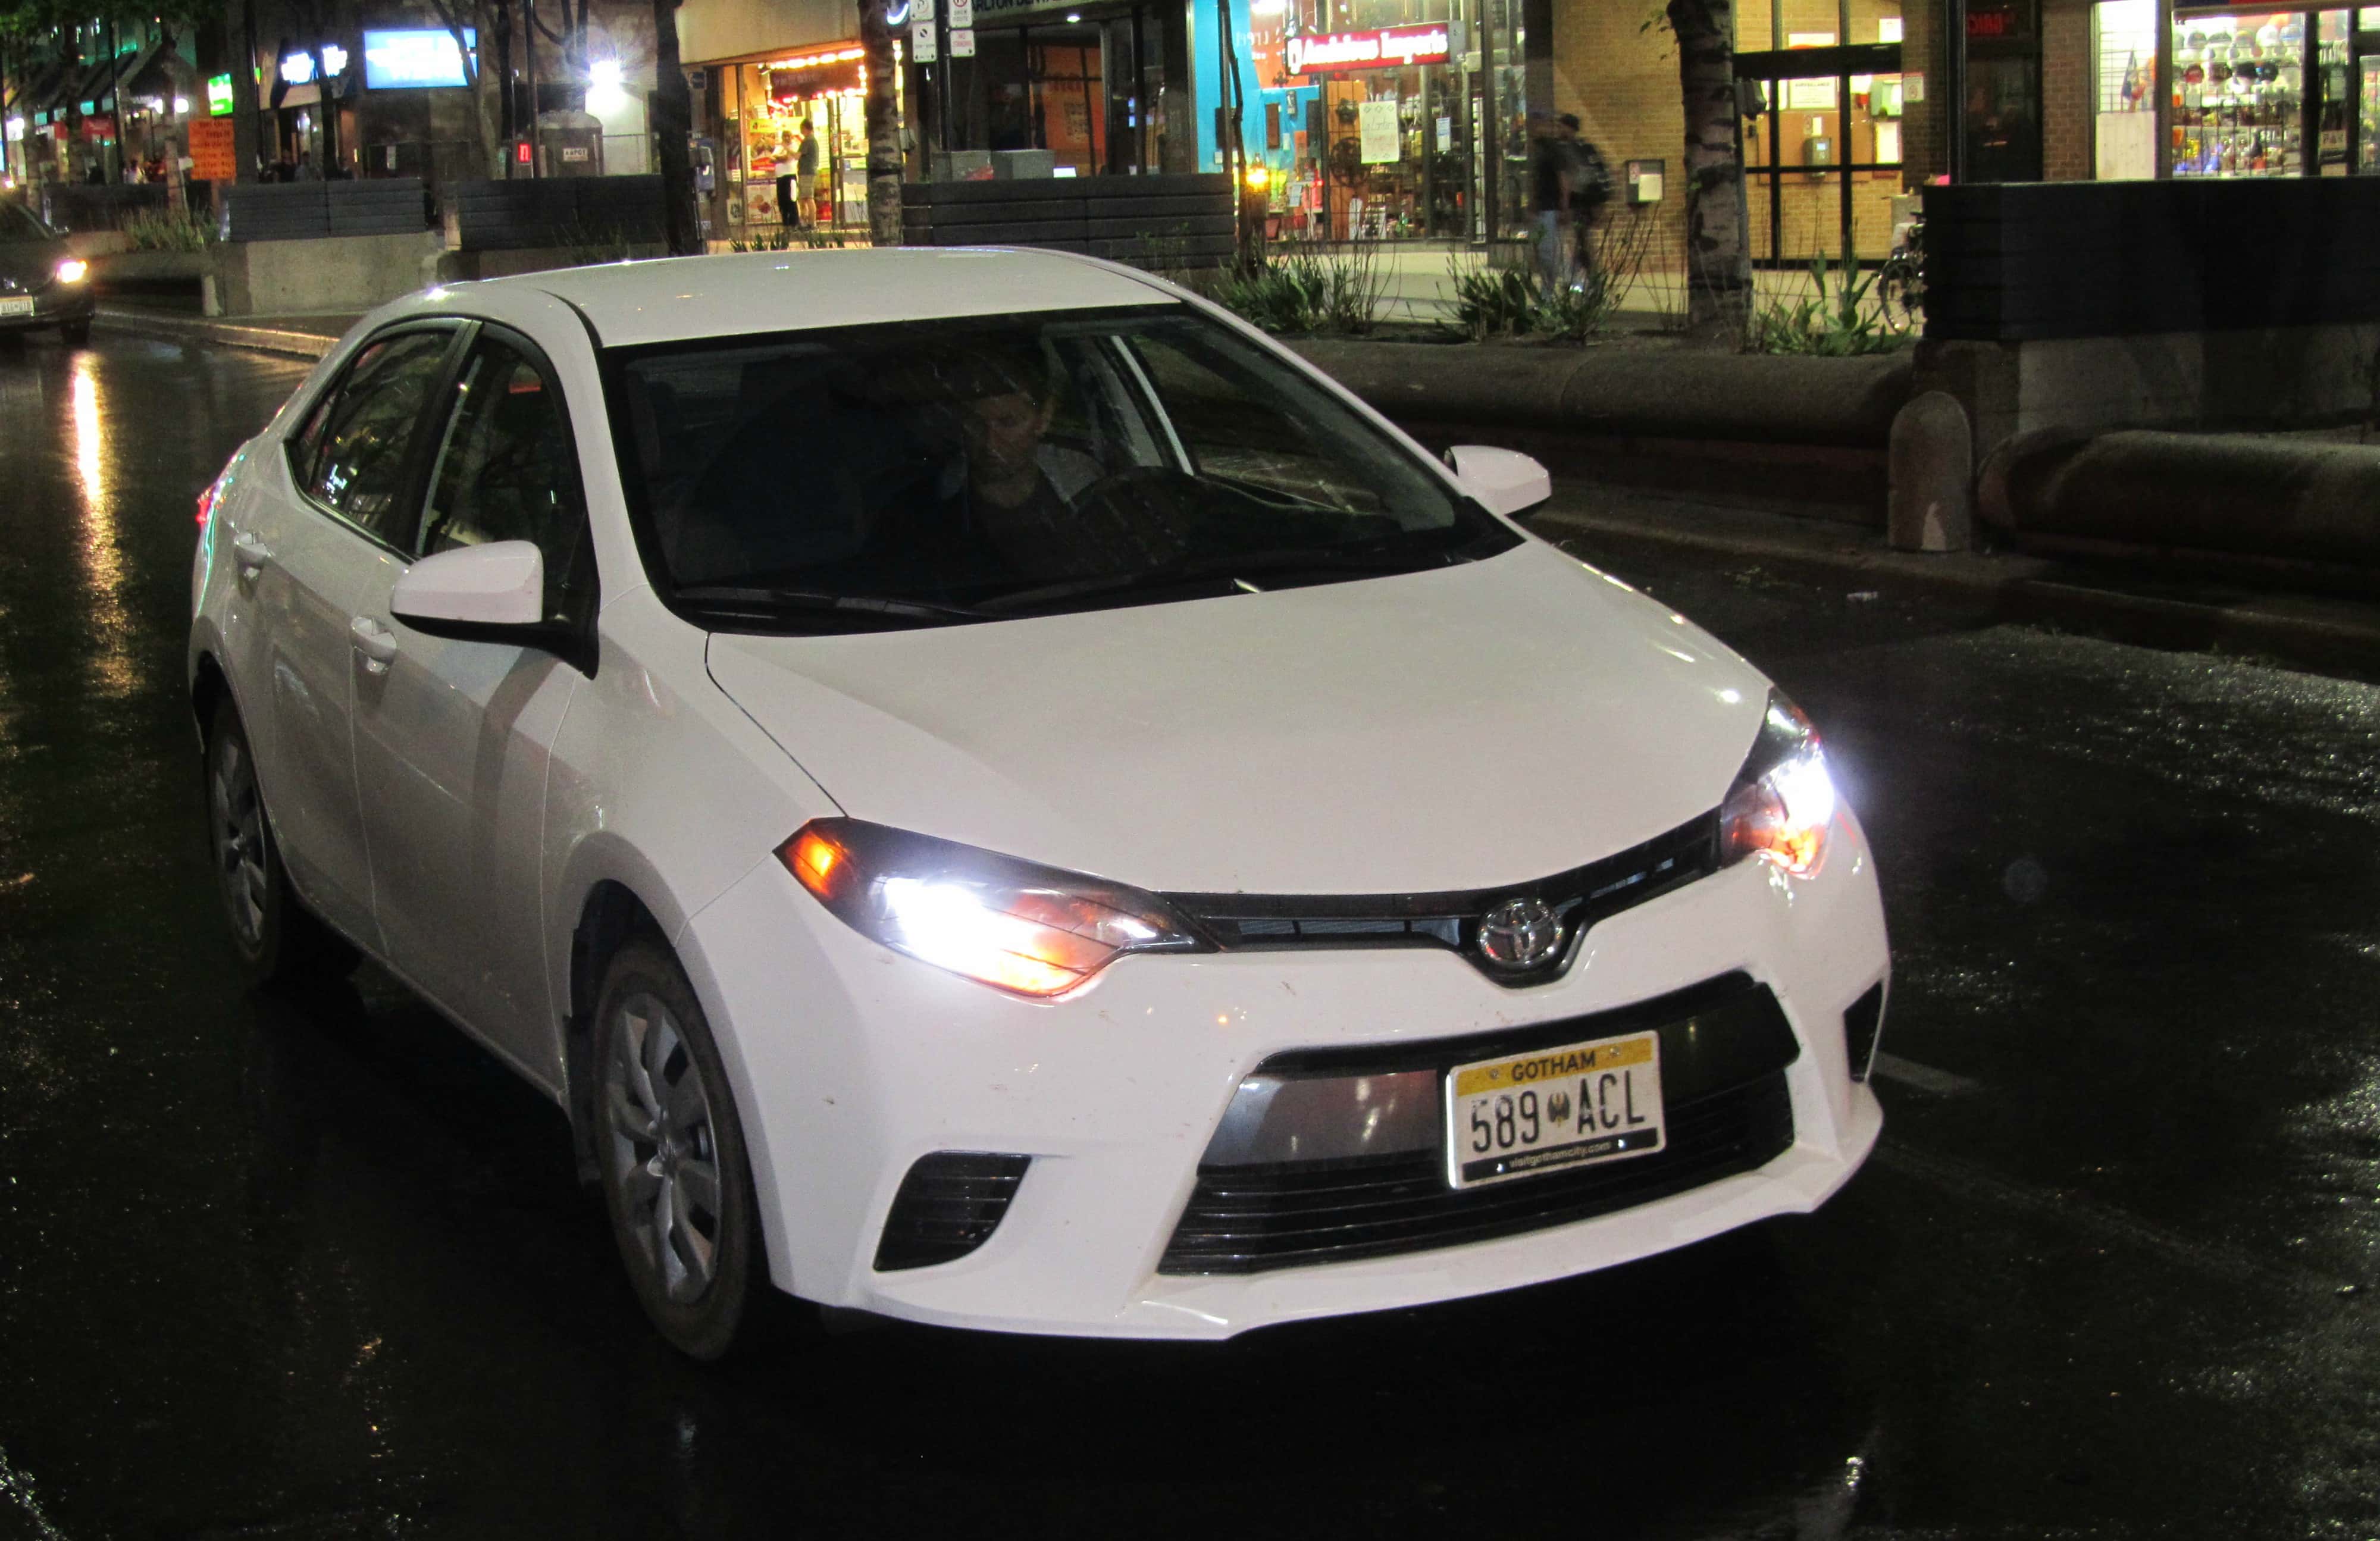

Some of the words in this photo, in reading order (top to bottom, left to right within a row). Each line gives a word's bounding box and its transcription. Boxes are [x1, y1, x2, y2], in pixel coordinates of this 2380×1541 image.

[1512, 1050, 1596, 1082] GOTHAM
[1471, 1090, 1540, 1153] 589
[1577, 1070, 1645, 1135] ACL
